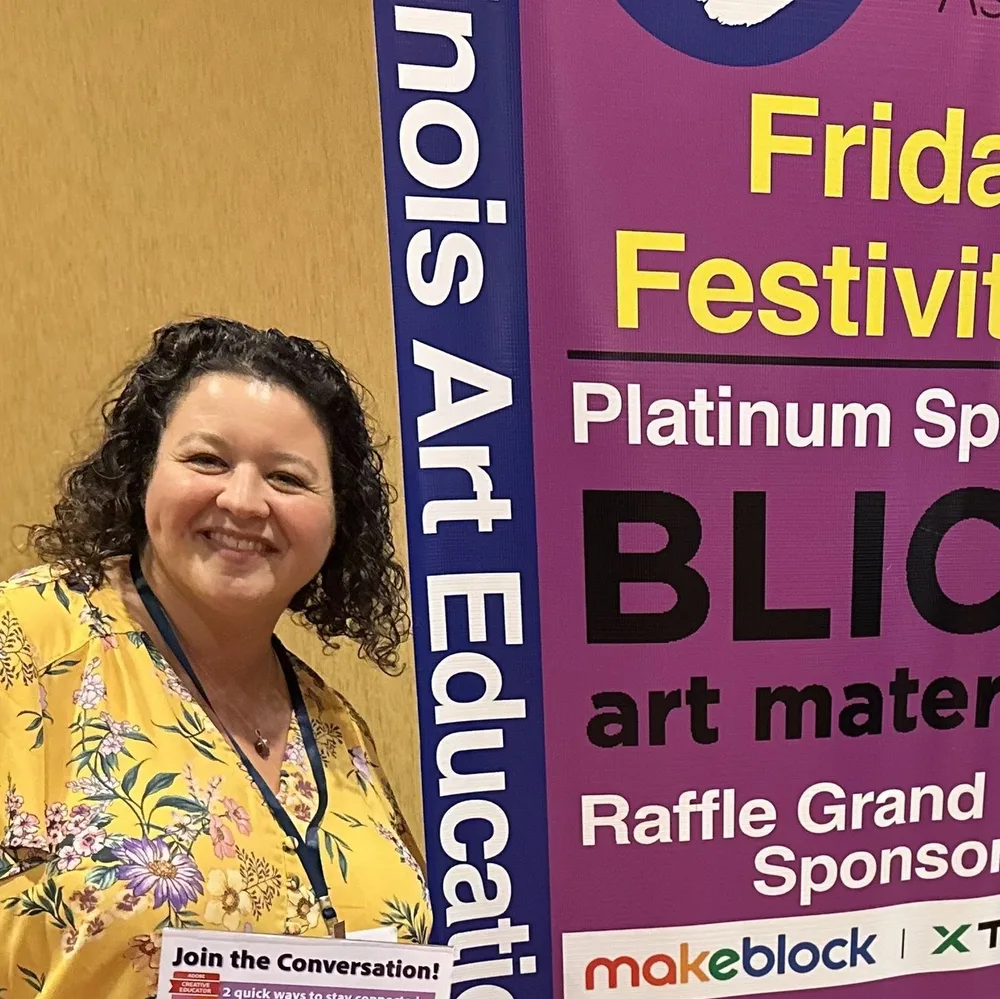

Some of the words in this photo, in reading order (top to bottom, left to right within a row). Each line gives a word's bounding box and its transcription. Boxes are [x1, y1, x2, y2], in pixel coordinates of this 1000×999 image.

[411, 338, 513, 535] Art
[571, 380, 891, 449] Platinum
[585, 675, 720, 749] art
[580, 788, 777, 847] Raffle
[797, 771, 986, 834] Grand
[172, 946, 224, 968] Join
[230, 949, 271, 970] the
[277, 953, 440, 980] Conversation!
[222, 987, 232, 998] 2
[585, 926, 877, 991] makeblock
